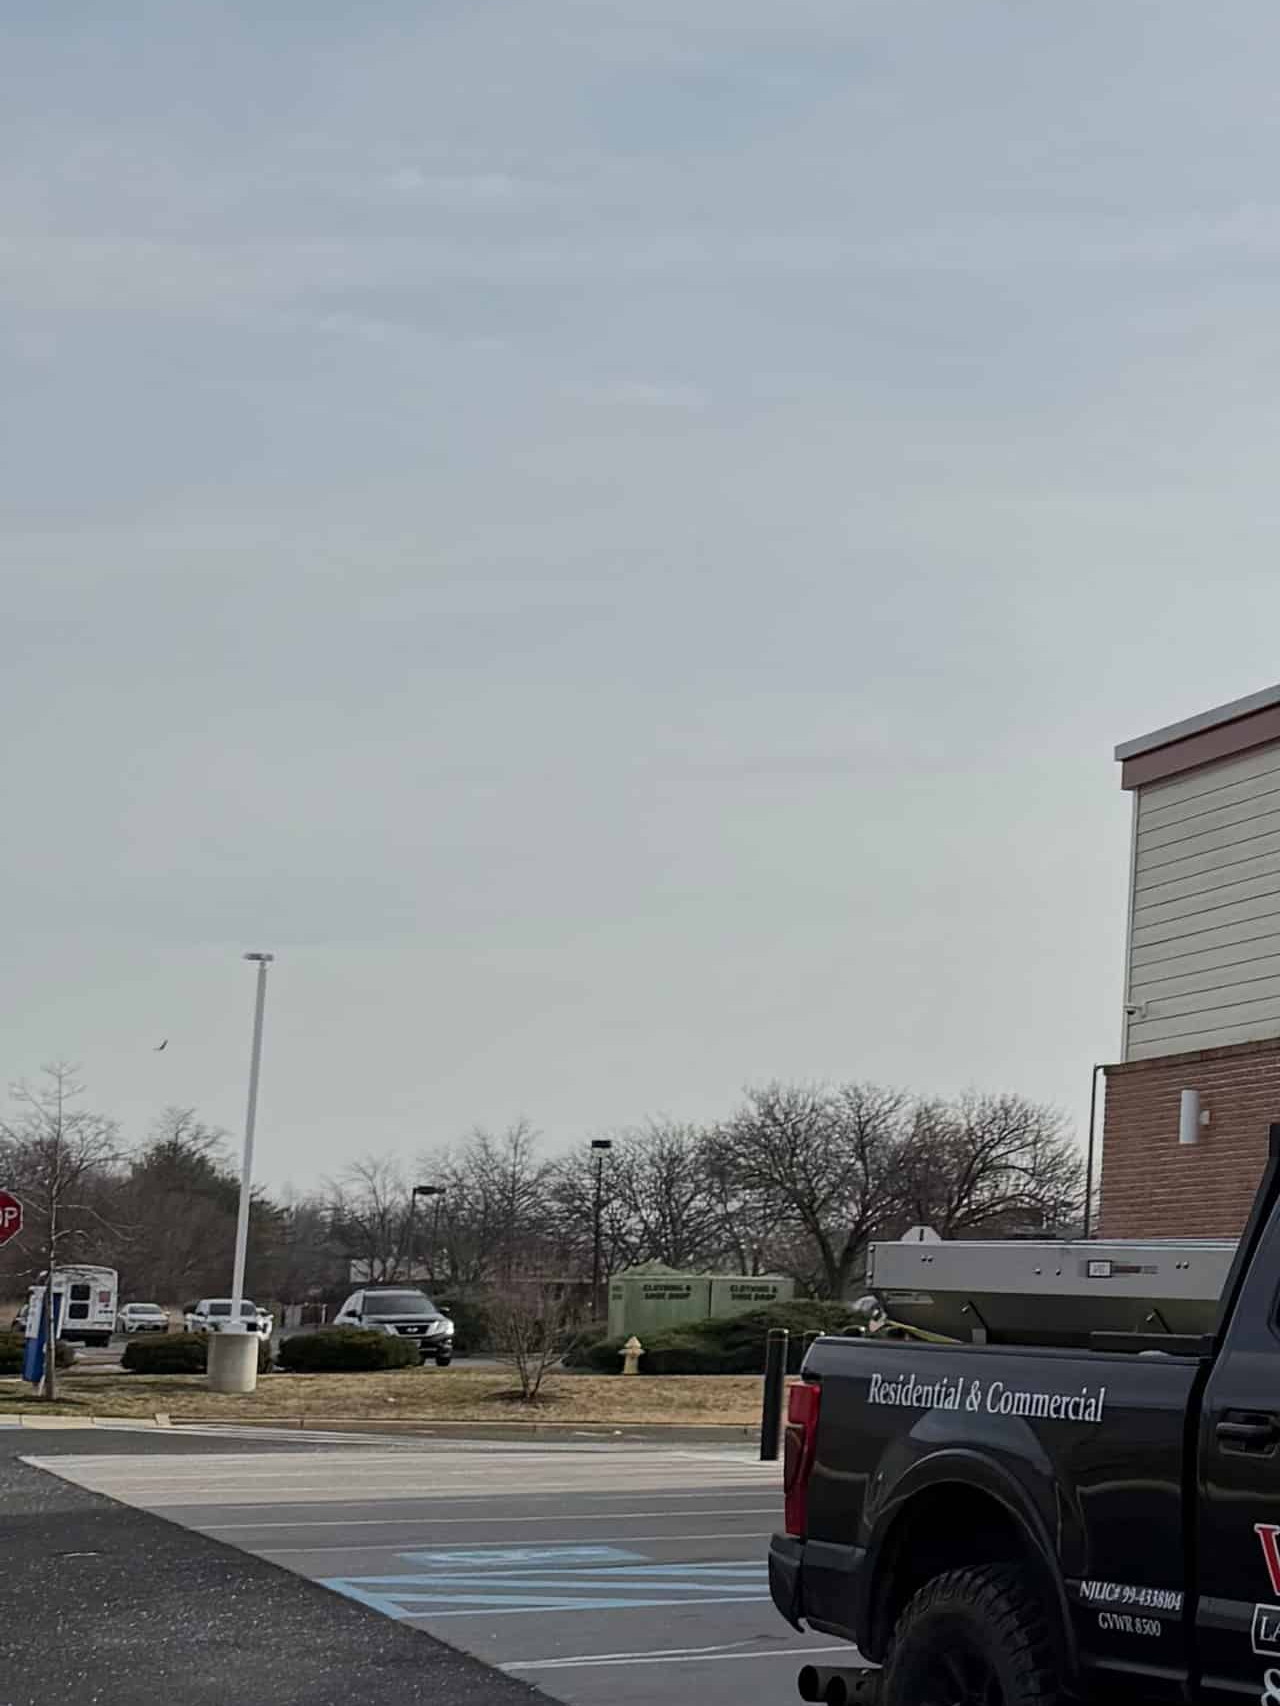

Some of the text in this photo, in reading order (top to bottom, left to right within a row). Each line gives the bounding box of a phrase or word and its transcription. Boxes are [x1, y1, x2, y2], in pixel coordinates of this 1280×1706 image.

[868, 1373, 1106, 1422] Residential & Commercial
[1135, 1617, 1161, 1636] 8500
